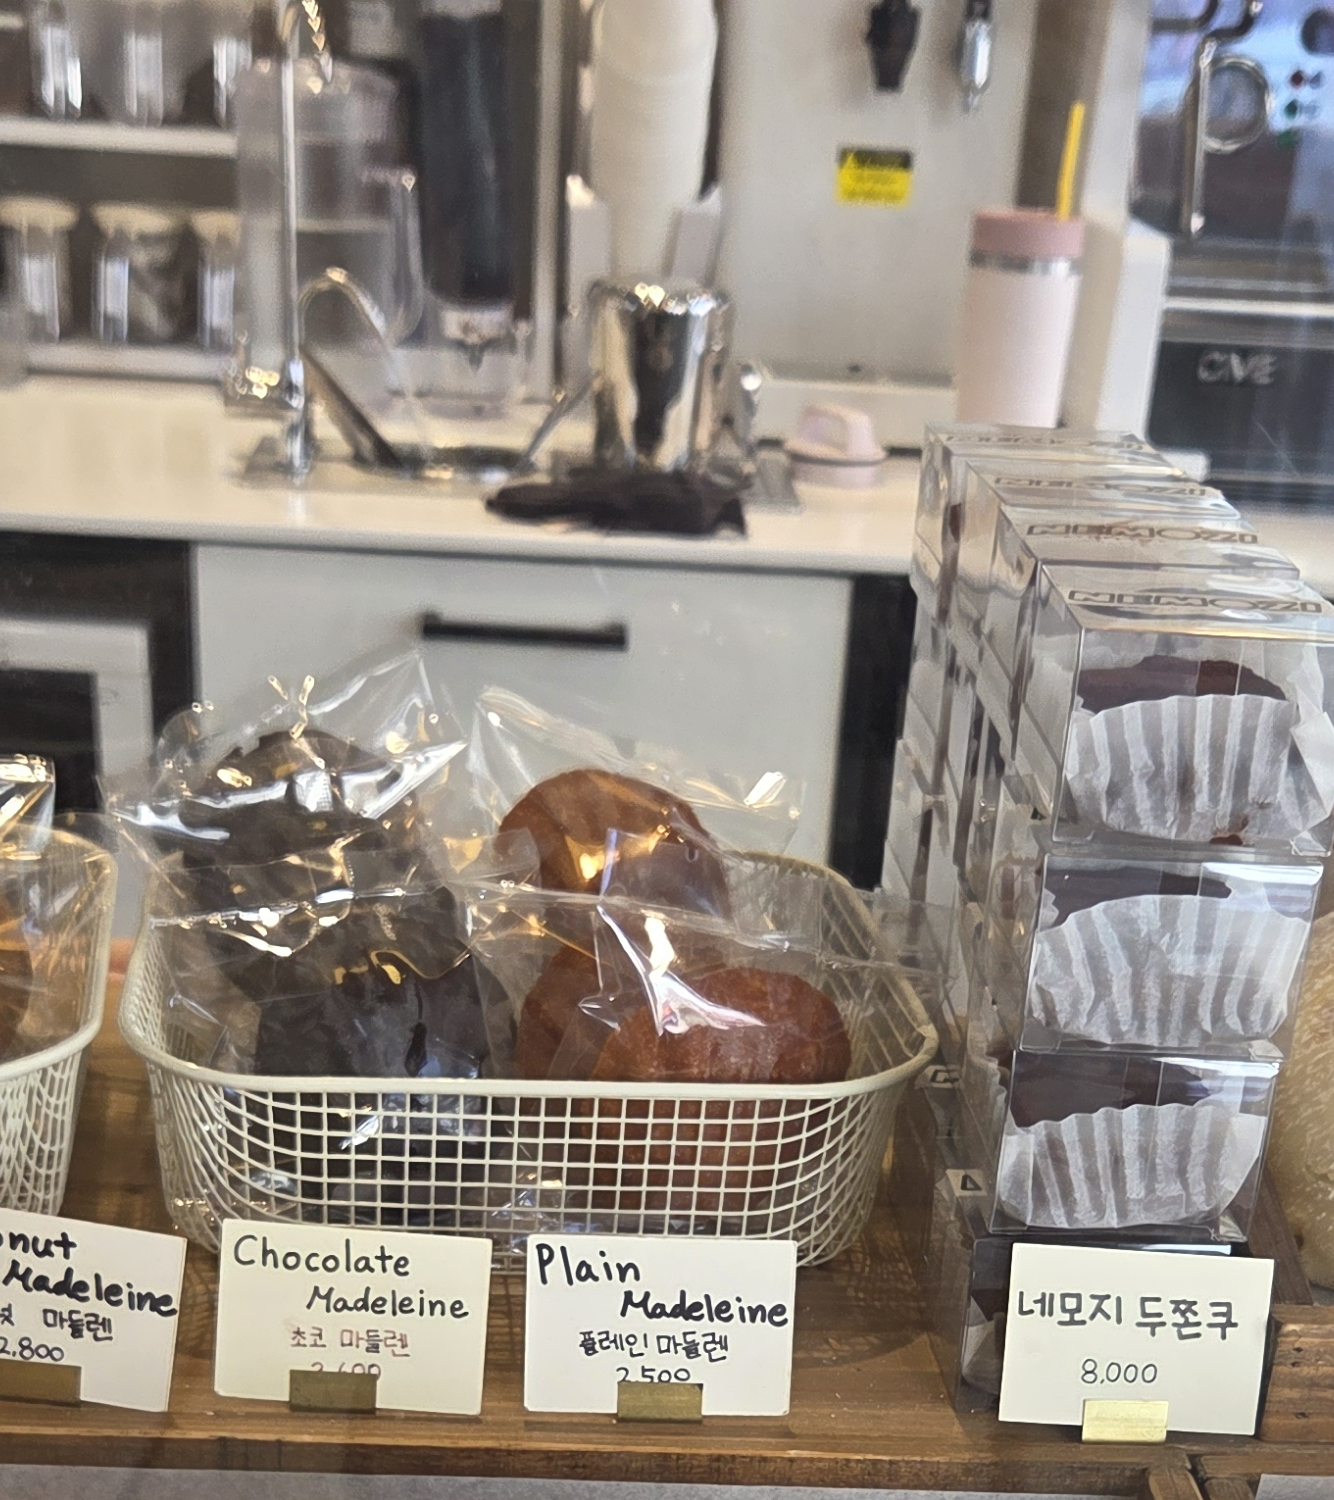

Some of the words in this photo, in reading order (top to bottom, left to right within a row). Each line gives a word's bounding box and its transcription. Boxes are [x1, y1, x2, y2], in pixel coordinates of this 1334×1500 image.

[233, 1234, 411, 1277] Chocolate
[535, 1242, 641, 1286] Plain
[2, 1258, 179, 1317] Madeleine
[305, 1285, 469, 1319] Madeleine
[42, 1308, 114, 1342] 마들렌
[619, 1289, 789, 1327] Madeleine
[1018, 1290, 1123, 1327] 네모지
[1135, 1296, 1239, 1341] 두쫀쿠
[290, 1326, 327, 1348] 초코
[340, 1328, 411, 1357] 마들렌
[578, 1330, 648, 1358] 플레인
[656, 1331, 729, 1363] 마들렌
[1080, 1358, 1158, 1385] 8,000
